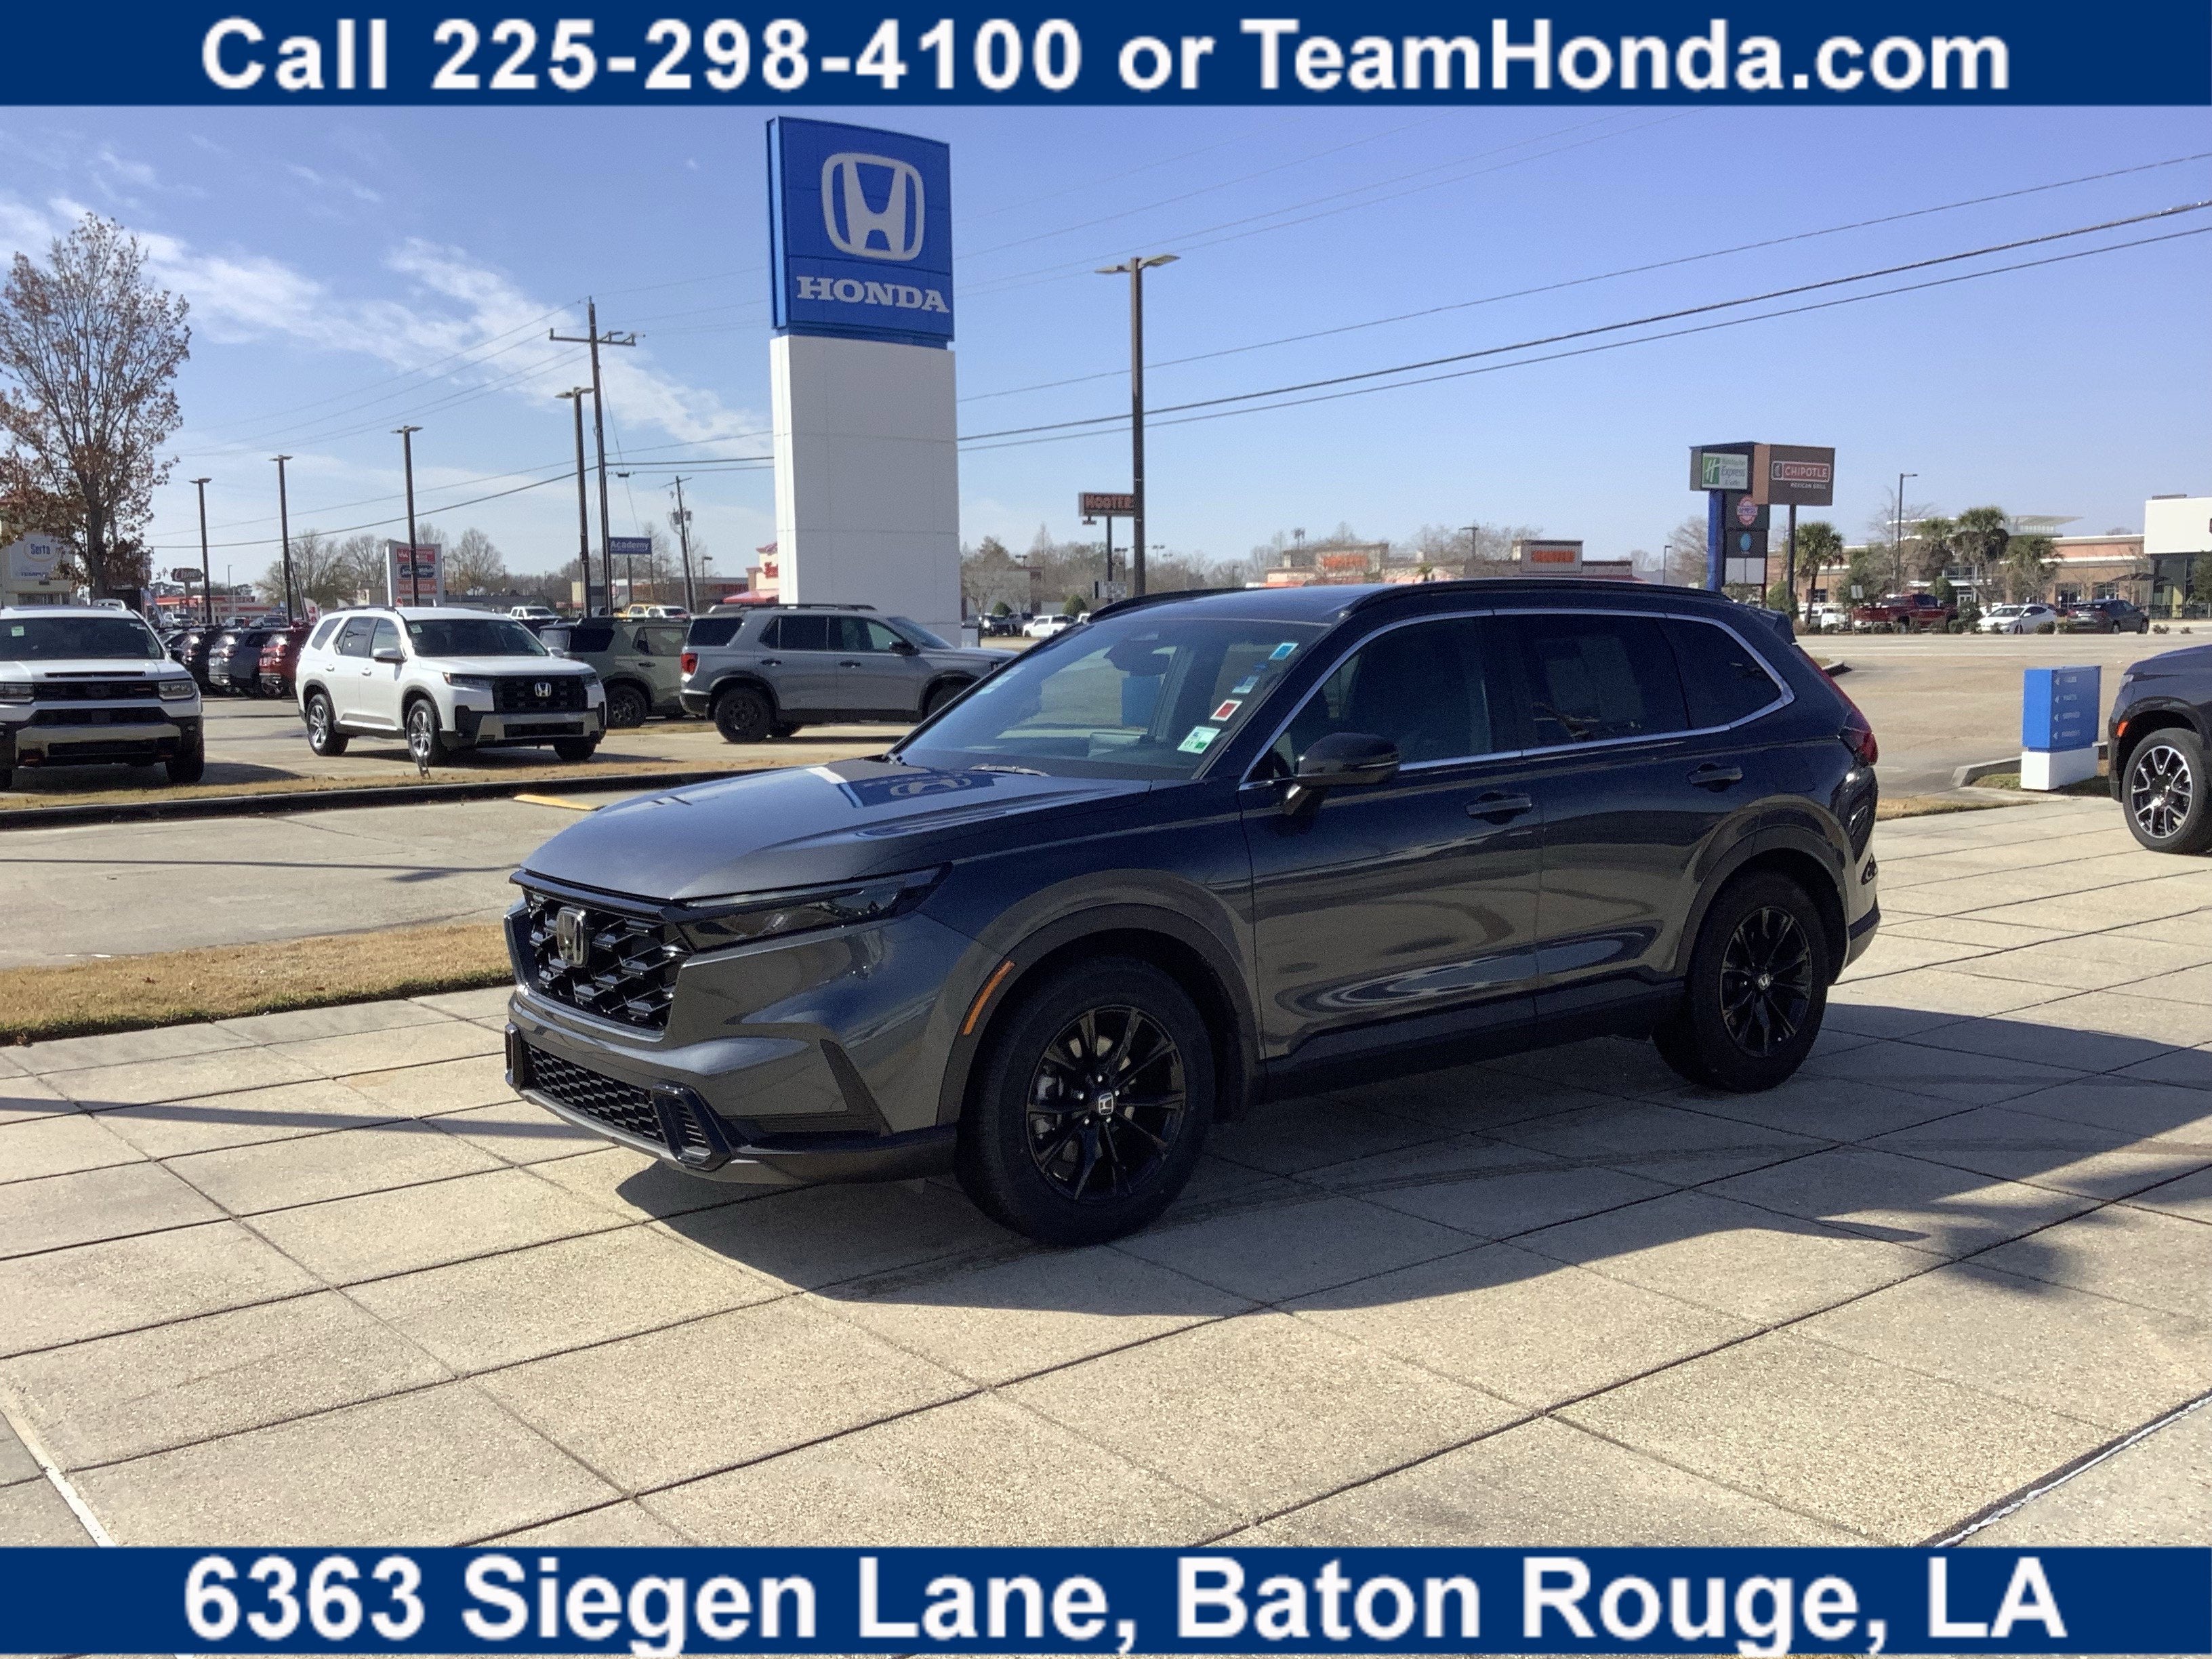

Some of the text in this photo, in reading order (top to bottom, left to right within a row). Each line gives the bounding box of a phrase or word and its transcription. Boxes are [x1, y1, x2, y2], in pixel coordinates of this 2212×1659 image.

[796, 276, 949, 313] HONDA
[1784, 466, 1828, 478] CHIPOTLE
[1085, 495, 1134, 510] HOOTER
[30, 544, 51, 555] Serta
[611, 540, 650, 551] Academy
